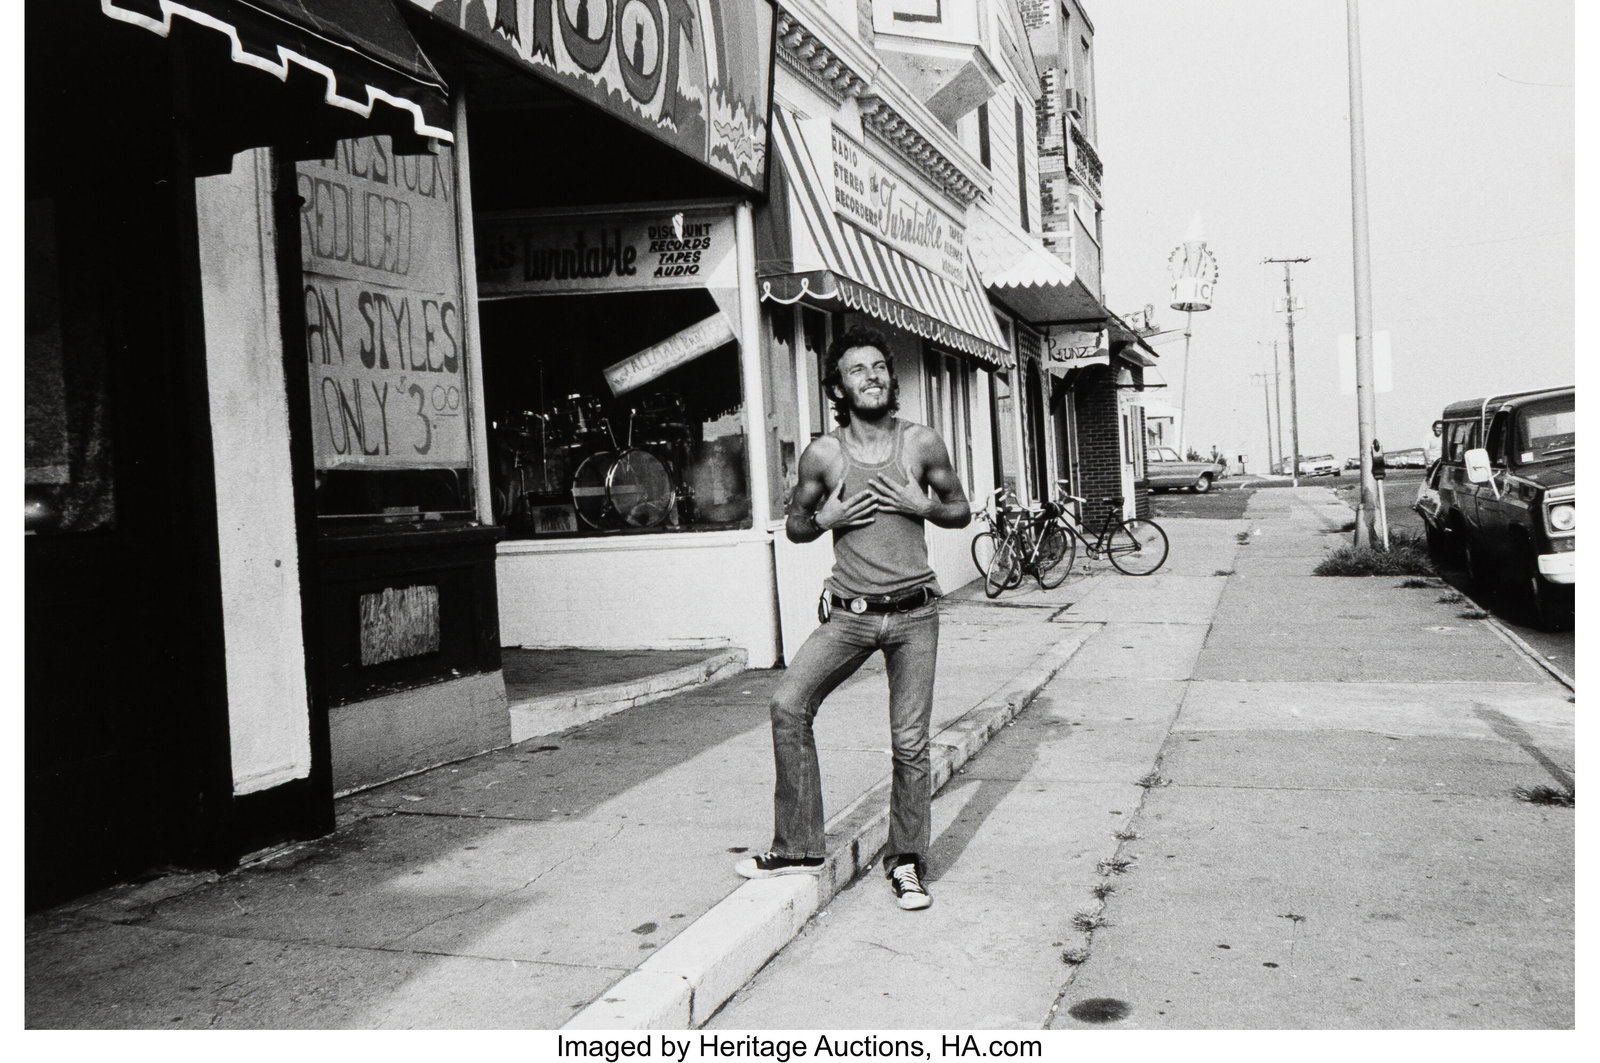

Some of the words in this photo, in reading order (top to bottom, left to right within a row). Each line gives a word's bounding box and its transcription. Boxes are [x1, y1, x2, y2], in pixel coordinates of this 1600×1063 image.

[831, 134, 857, 168] RADIO
[833, 161, 864, 195] STEREO
[299, 172, 412, 276] REDUCED
[834, 185, 878, 227] RECORDERS
[878, 177, 943, 249] Turntable
[648, 223, 711, 240] DISCUNT
[649, 237, 711, 252] RECORDS
[518, 227, 637, 281] Turntable
[654, 265, 700, 277] AUDIO
[659, 251, 701, 265] TAPES
[304, 284, 345, 365] AN
[357, 291, 460, 374] STYLES
[321, 376, 390, 456] ONLY
